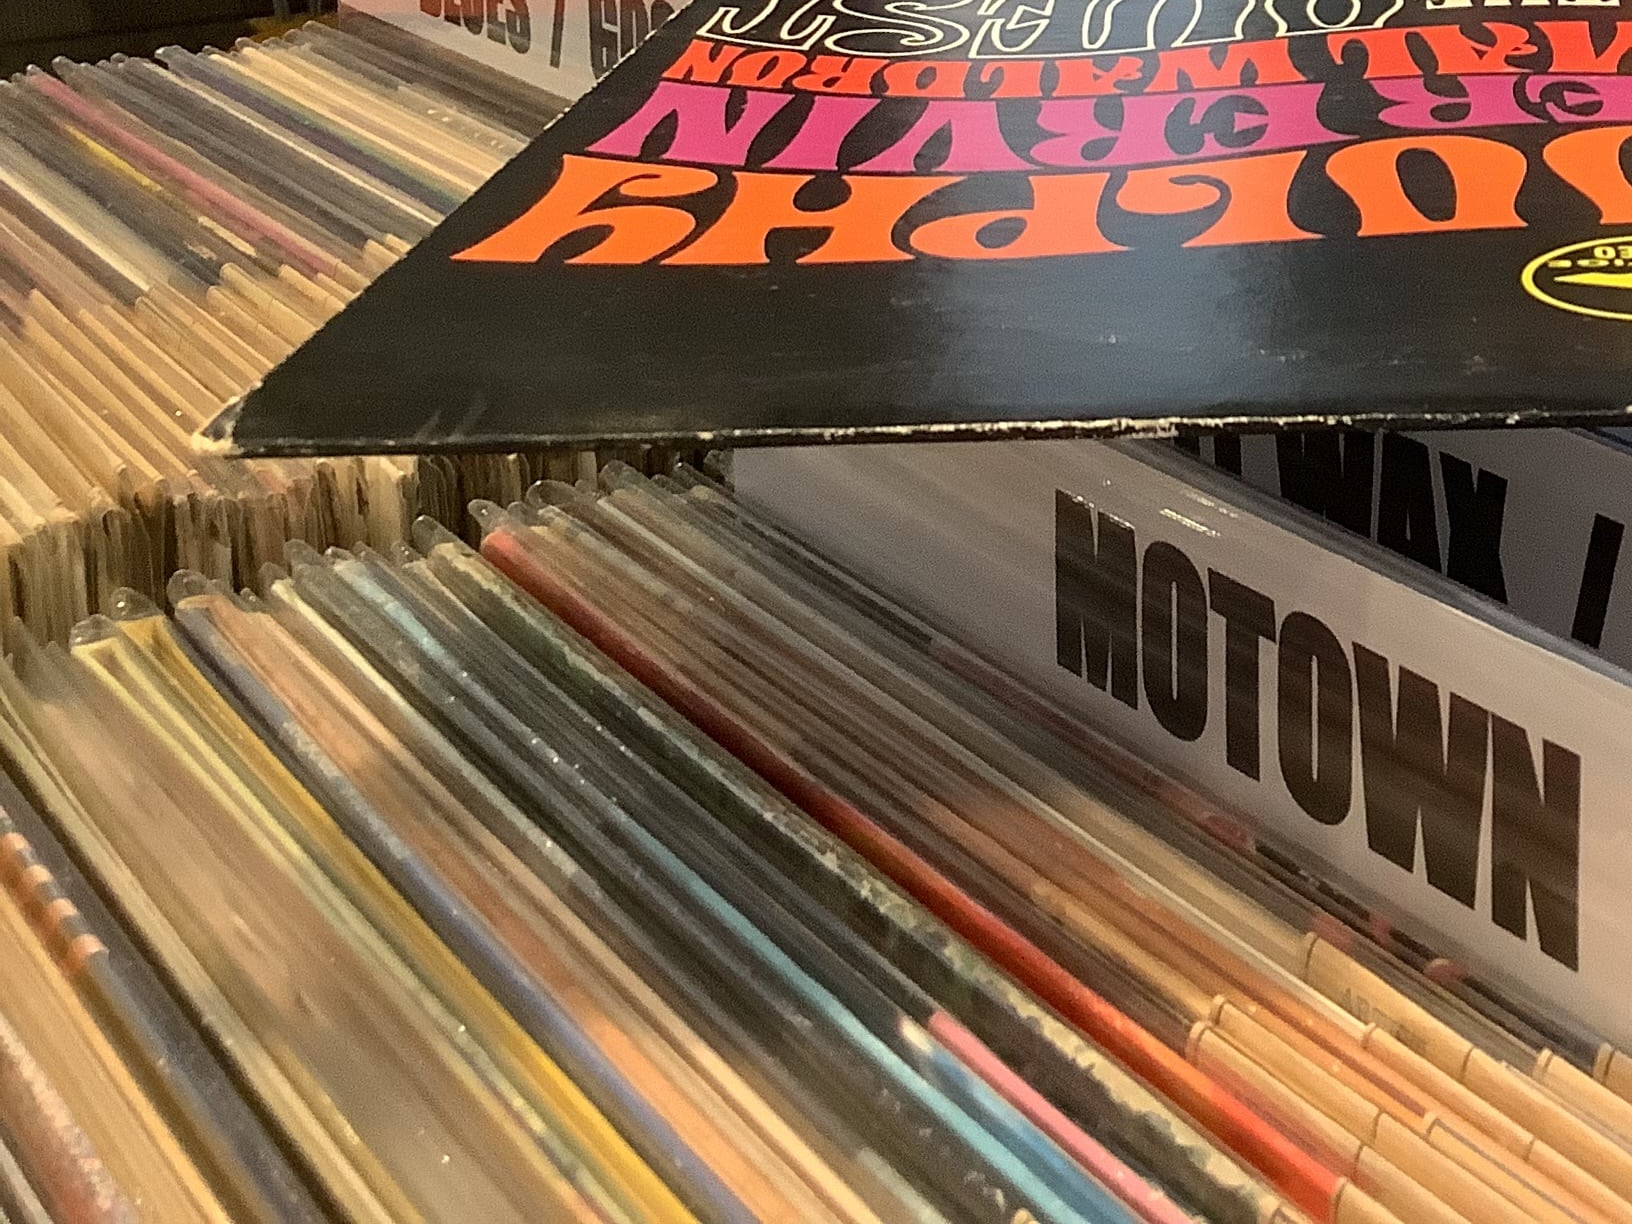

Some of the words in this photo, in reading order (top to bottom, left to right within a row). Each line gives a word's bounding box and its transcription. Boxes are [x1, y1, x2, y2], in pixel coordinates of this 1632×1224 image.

[663, 36, 1309, 100] WALDRON
[585, 78, 1361, 173] ERVIN
[1054, 487, 1582, 973] MOTOWN
